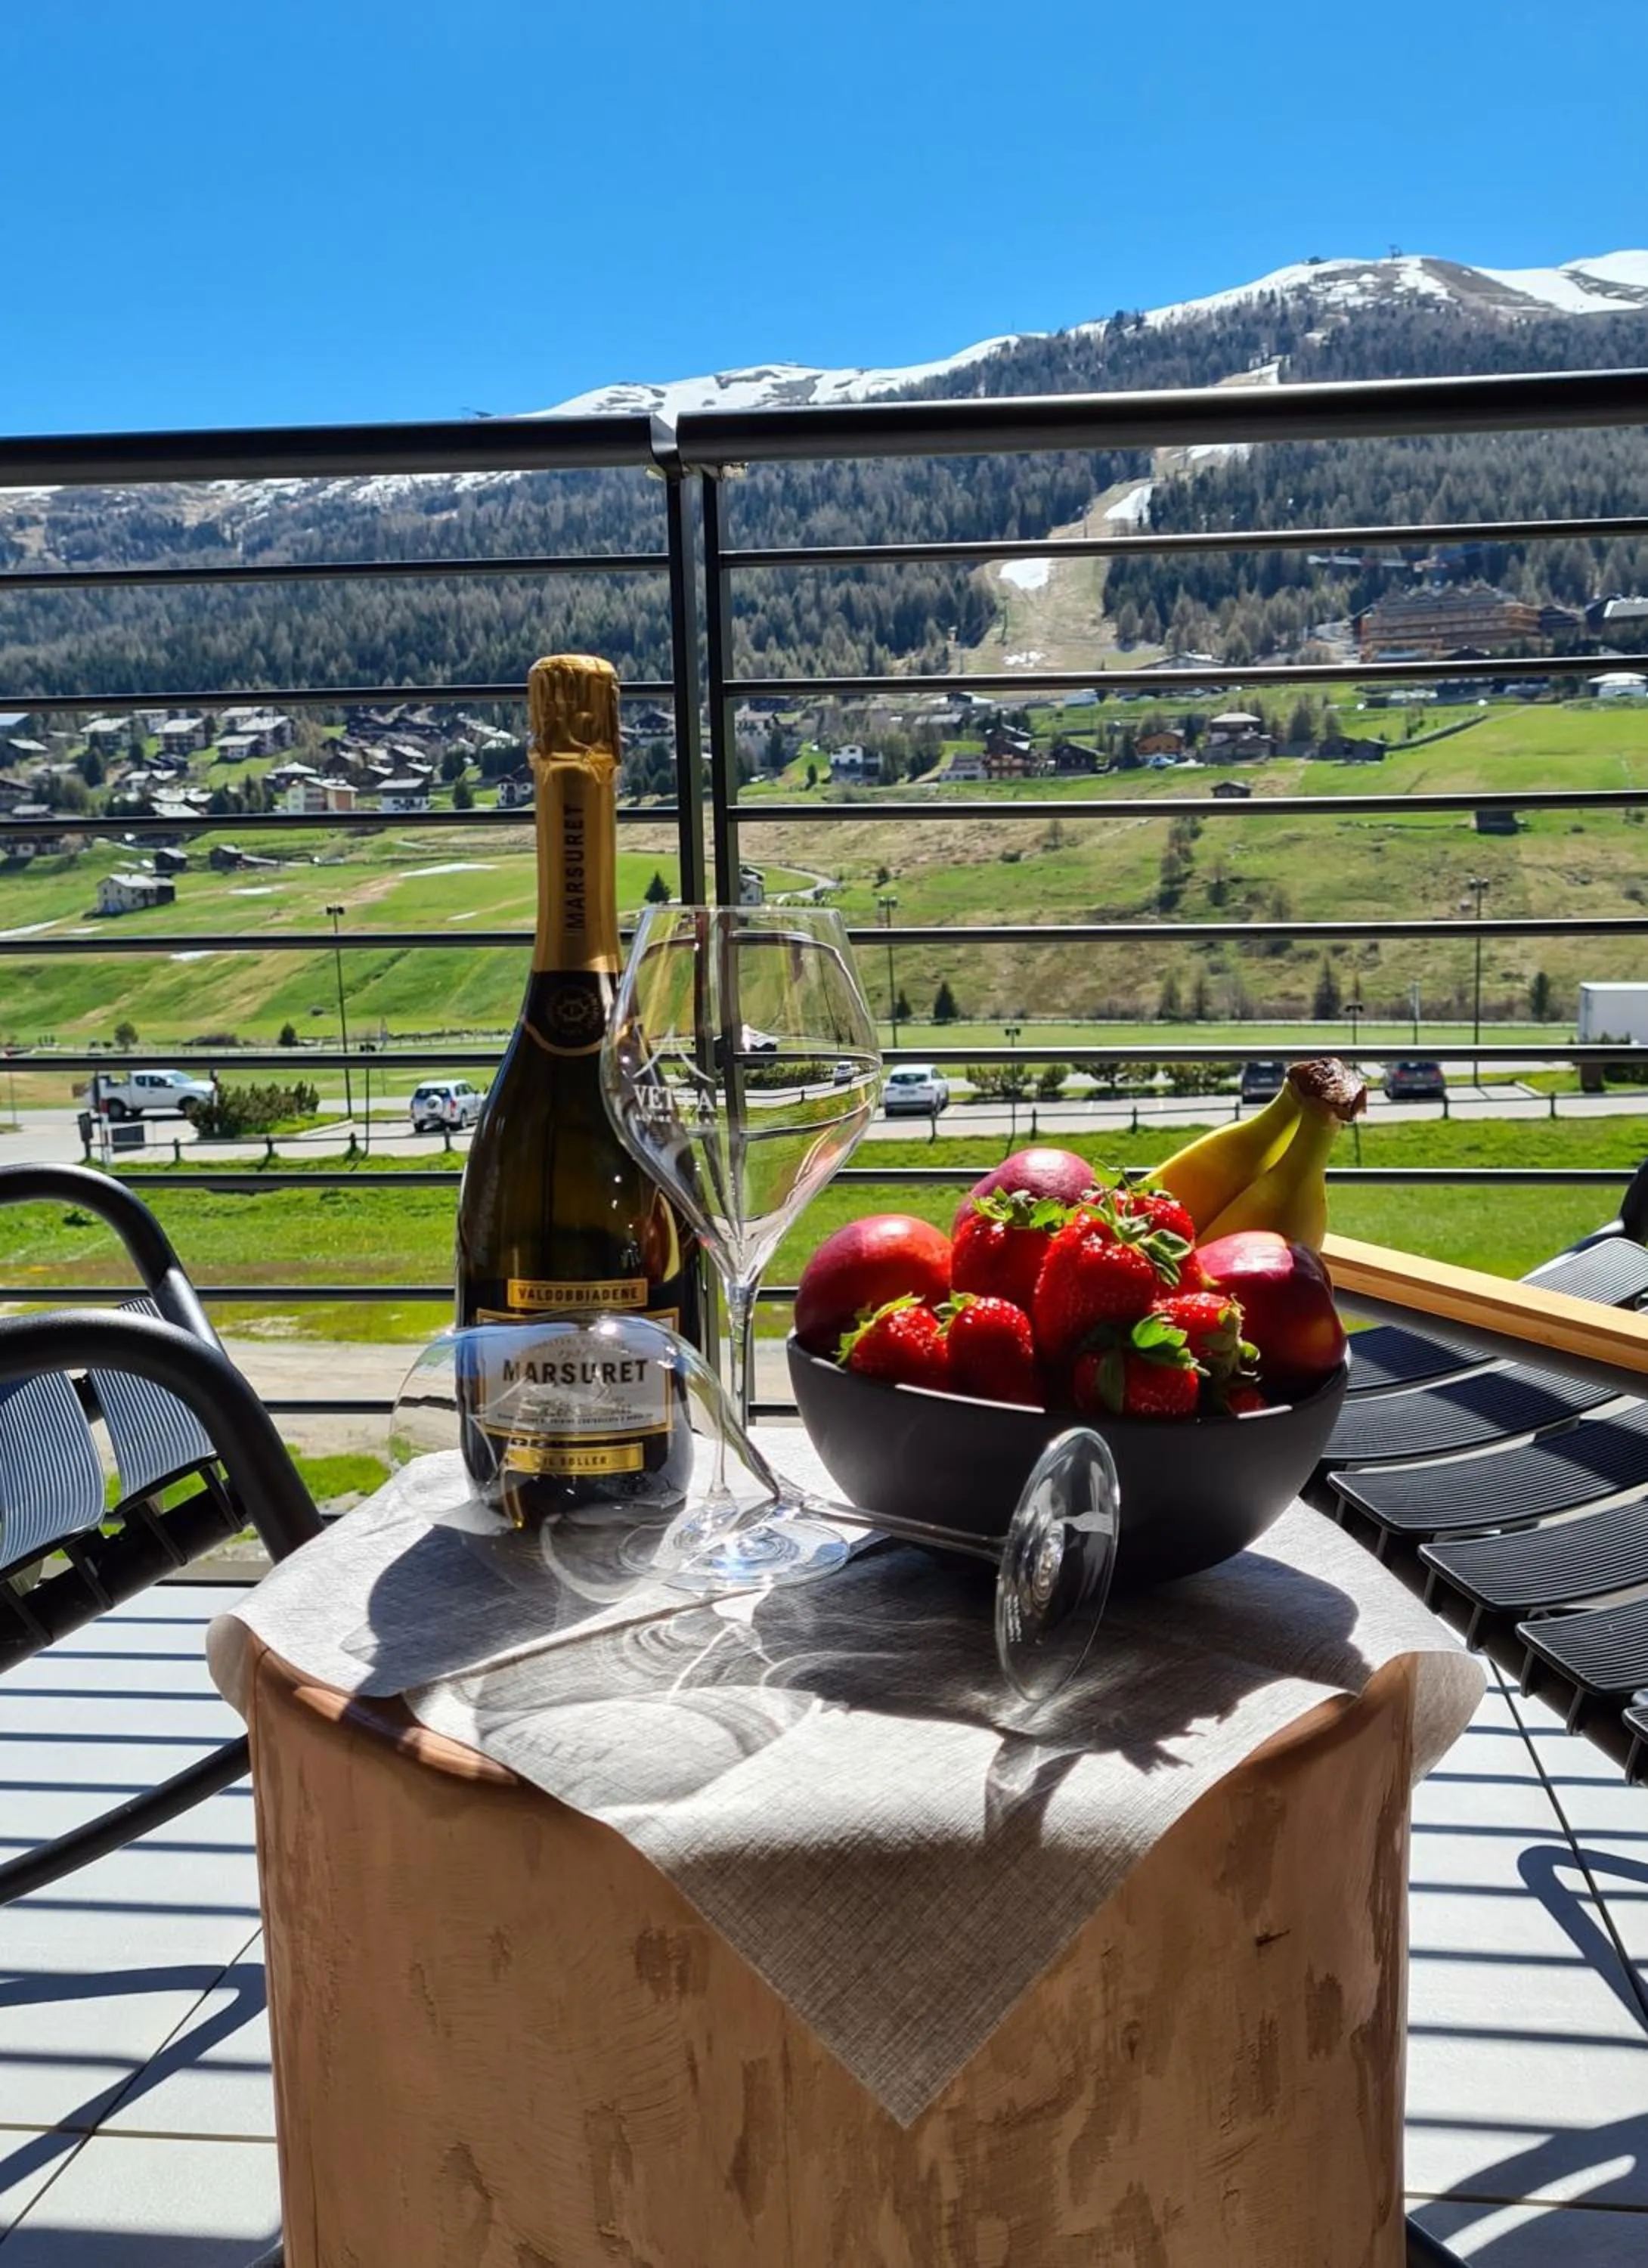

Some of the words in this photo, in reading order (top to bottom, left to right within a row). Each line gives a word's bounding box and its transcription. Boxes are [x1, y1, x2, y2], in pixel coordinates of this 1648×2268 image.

[563, 803, 585, 929] MARSURET
[632, 1085, 715, 1111] VETA
[518, 1286, 639, 1302] VALDOBBIADENE
[503, 1359, 649, 1384] MARSURET
